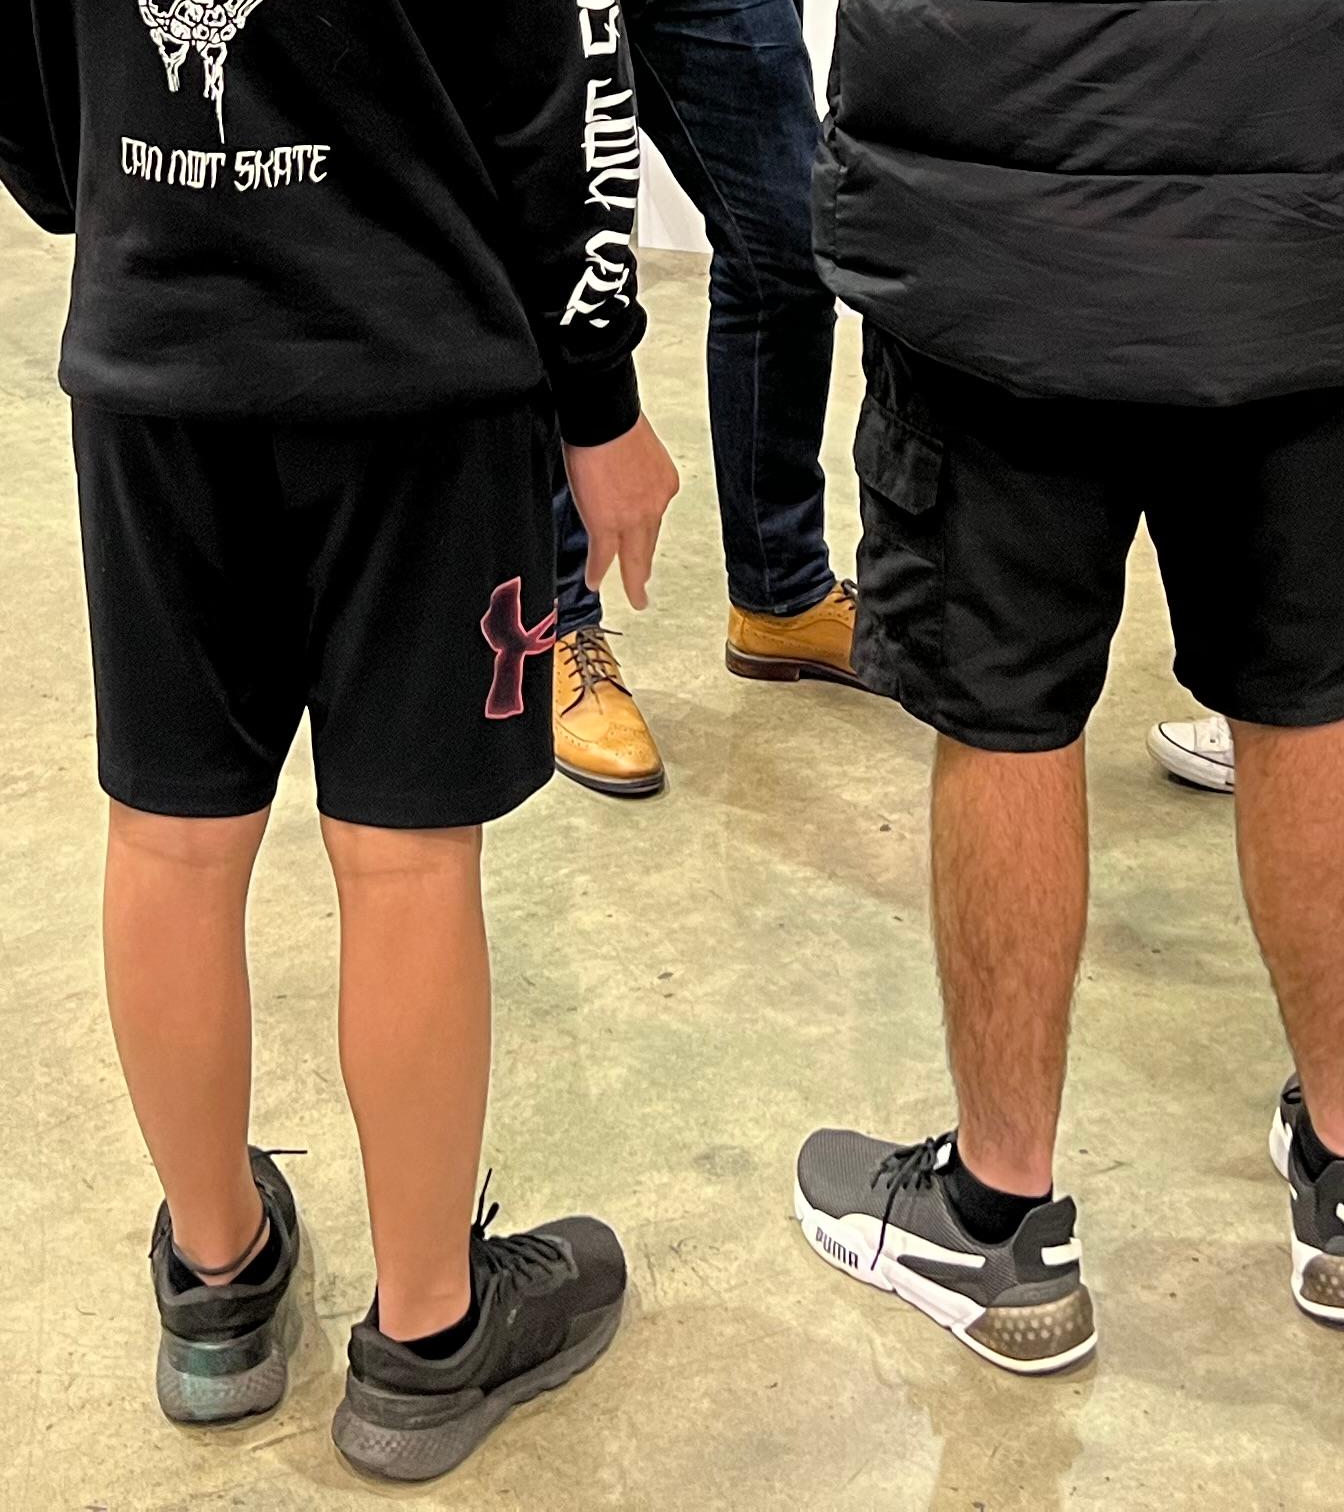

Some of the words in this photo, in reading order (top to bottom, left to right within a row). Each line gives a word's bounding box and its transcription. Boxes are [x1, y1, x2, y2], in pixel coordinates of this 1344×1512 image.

[121, 136, 163, 183] CAN
[167, 149, 227, 189] NOT
[234, 144, 331, 191] SKATE
[816, 1226, 859, 1270] PUMA
